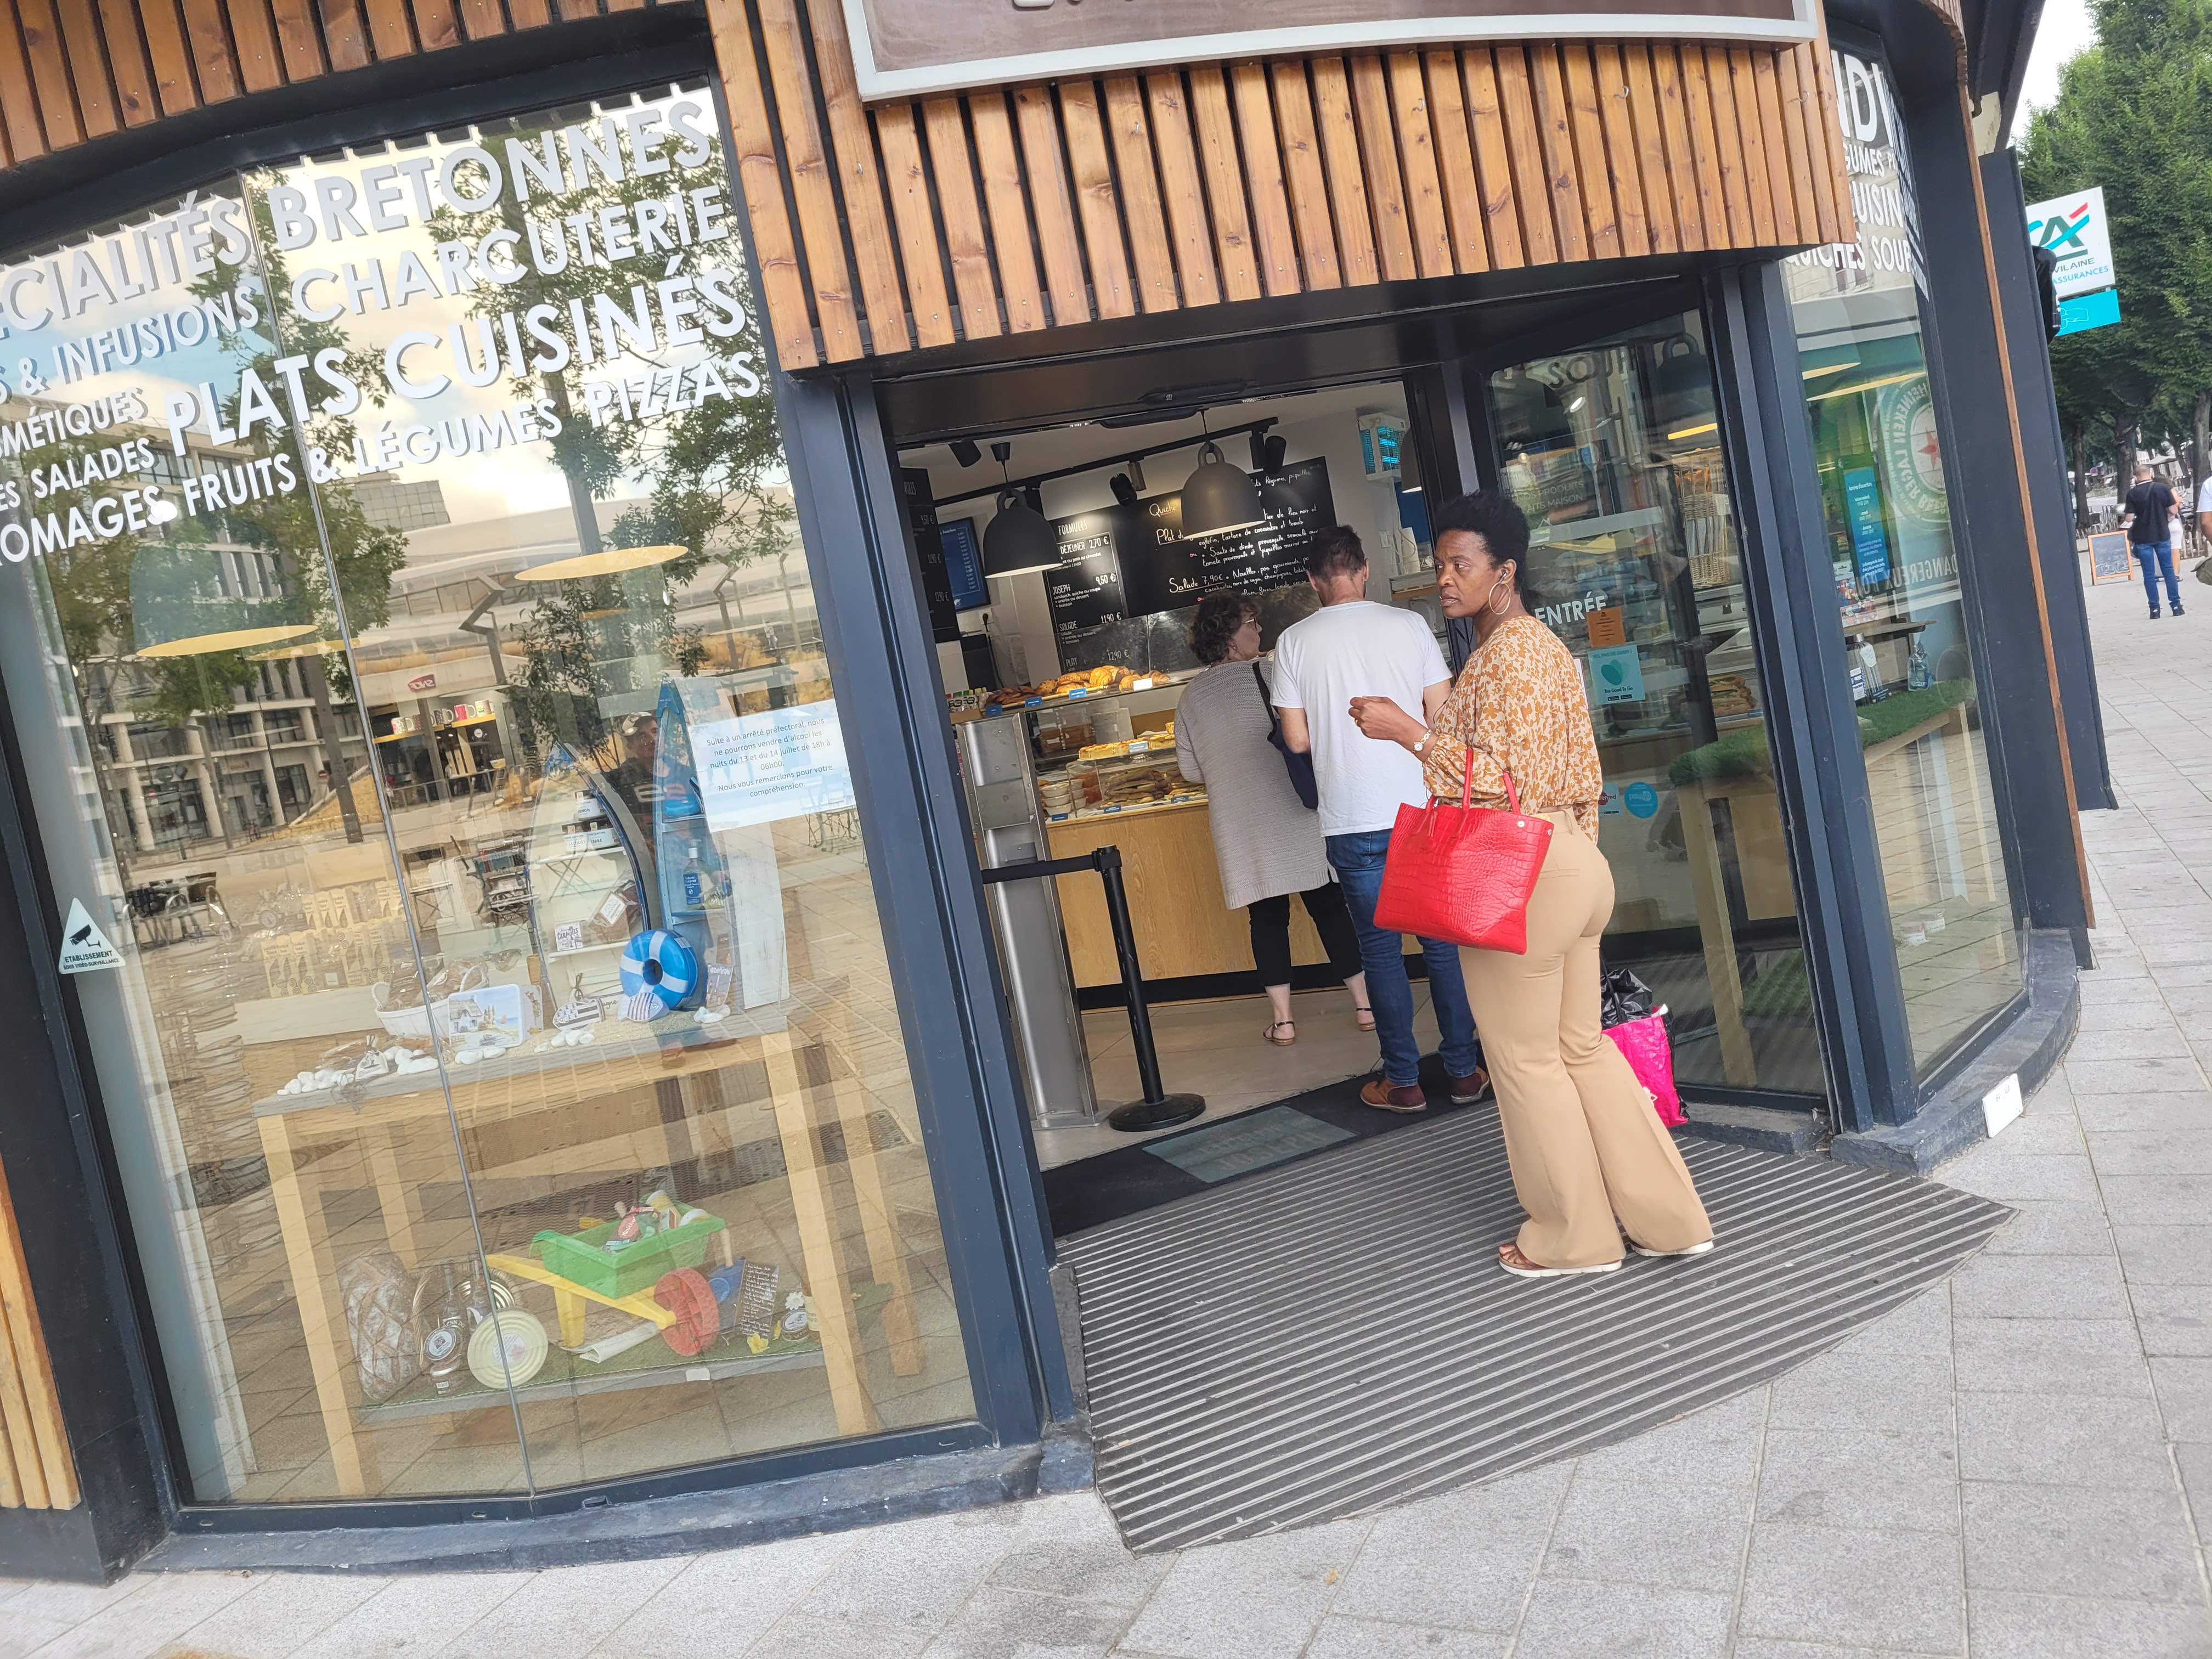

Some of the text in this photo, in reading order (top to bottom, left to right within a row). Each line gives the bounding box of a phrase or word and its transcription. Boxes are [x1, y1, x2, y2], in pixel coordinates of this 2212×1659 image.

[1849, 181, 1904, 228] UISIN
[0, 101, 710, 339] CIALITÉS BRETONNES
[2052, 266, 2109, 284] ASSURANCES
[2054, 258, 2095, 273] VILAINE
[18, 357, 50, 395] &
[52, 285, 259, 385] INFUSIONS
[291, 184, 729, 323] CHARCUTERIE
[163, 255, 746, 457] PLATS CUISINÉS
[0, 387, 148, 459] MÉTIQUES
[0, 352, 761, 566] OMAGES FRUITS & LÉGUMES PIZZAS
[31, 437, 155, 499] SALADES
[1538, 480, 1584, 496] PRODUITS
[1149, 501, 1177, 517] Quiche
[1547, 494, 1583, 507] MAISON
[1058, 520, 1087, 536] FORMULES
[1156, 528, 1175, 544] Plat
[1088, 538, 1102, 549] 2,70
[1103, 536, 1109, 545] €
[1052, 573, 1116, 595] JOSEPH 9,50 €
[1169, 577, 1199, 593] Salade
[1059, 612, 1122, 632] SALADE 11,90 €
[1065, 649, 1130, 667] PLAT 12,90 €
[707, 737, 725, 746] Suite
[742, 729, 764, 740] arrêté
[766, 720, 806, 736] préfectoral,
[808, 718, 825, 727] nous
[724, 743, 757, 756] pourrons
[758, 738, 782, 748] vendre
[783, 731, 811, 743] d'alcool
[710, 760, 727, 769] nuits
[780, 746, 800, 756] juillet
[812, 740, 825, 749] 18h
[760, 760, 785, 771] 06h00.
[718, 765, 833, 792] Nous vous remercions pour votre
[750, 782, 806, 797] compréhension.
[64, 950, 112, 963] ETABLISSEMENT
